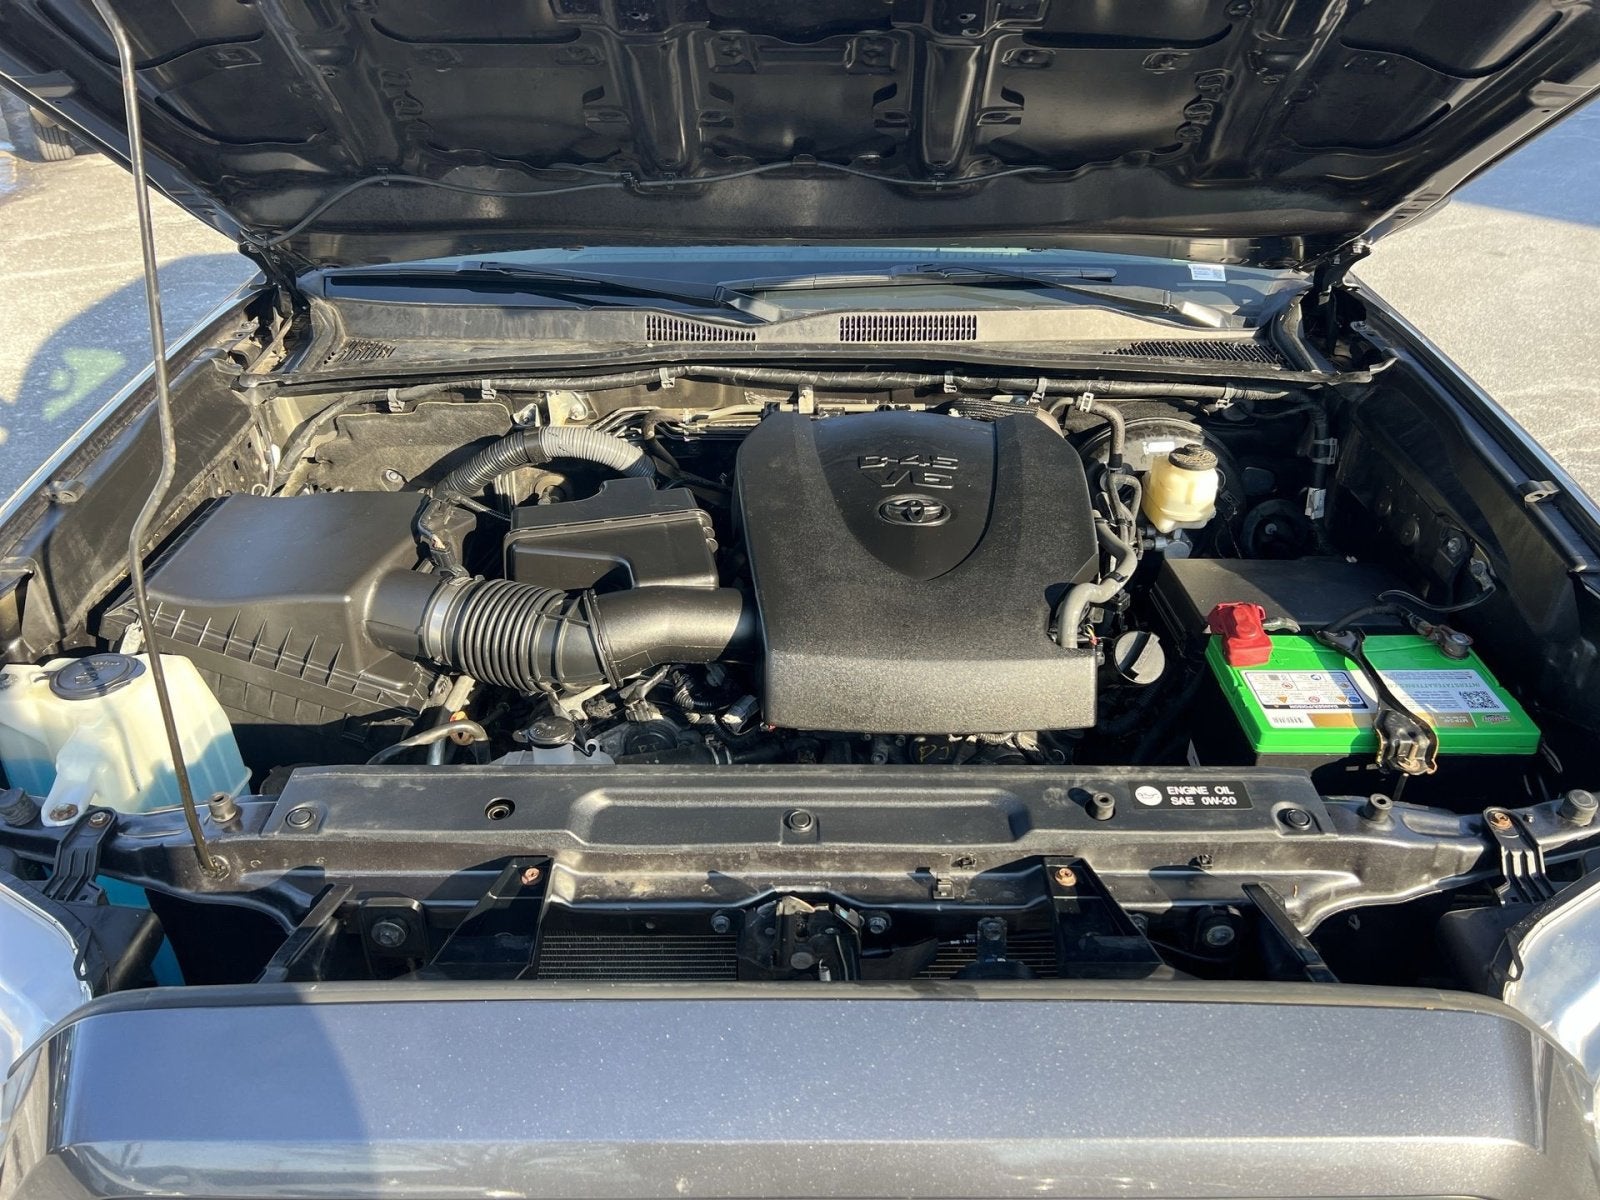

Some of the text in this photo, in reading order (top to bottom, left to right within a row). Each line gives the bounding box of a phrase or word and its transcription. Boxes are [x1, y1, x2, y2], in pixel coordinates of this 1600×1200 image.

[862, 470, 954, 489] V6
[1166, 786, 1235, 795] ENGINE OIL
[1171, 797, 1237, 806] SAE 0W-20
